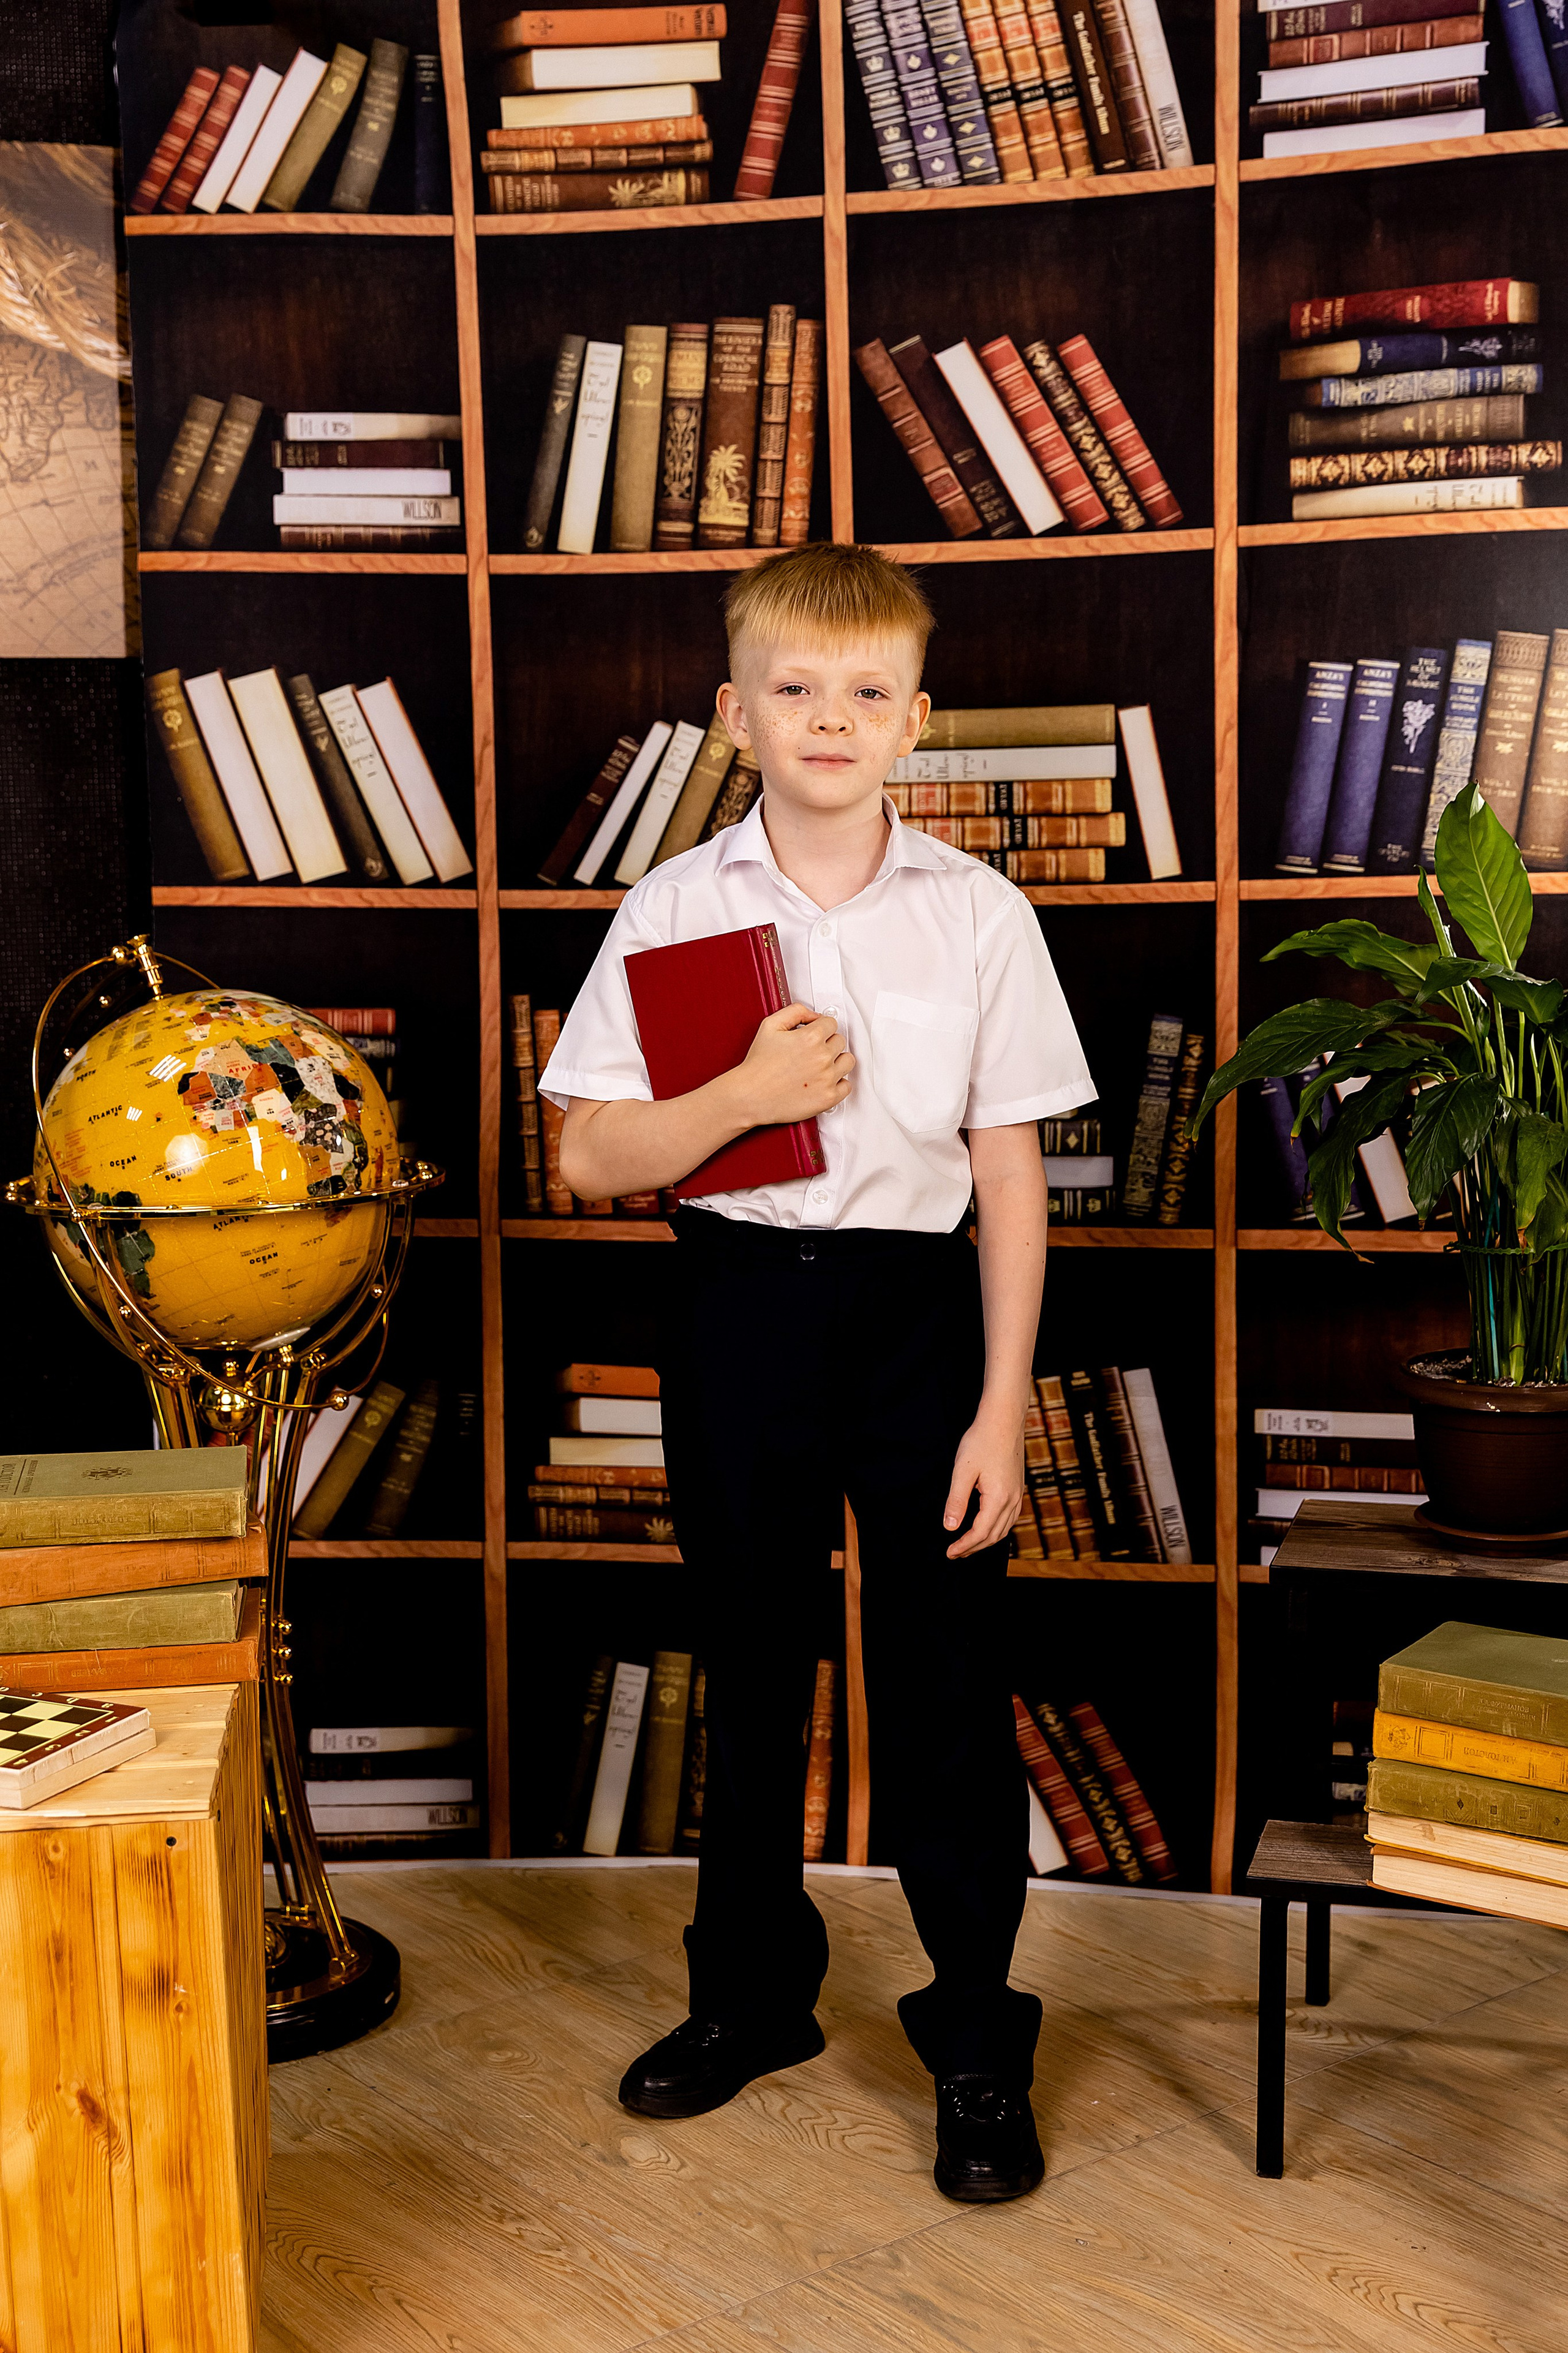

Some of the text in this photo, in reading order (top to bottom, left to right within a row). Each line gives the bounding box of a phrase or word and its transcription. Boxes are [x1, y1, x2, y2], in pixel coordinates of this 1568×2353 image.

[88, 1105, 123, 1122] ATLANTIC
[110, 1155, 137, 1167] OCEAN
[165, 1166, 192, 1181] SOUTH
[249, 1252, 279, 1265] OCEAN
[1096, 1472, 1111, 1498] Family
[1160, 1504, 1186, 1548] WILLSON
